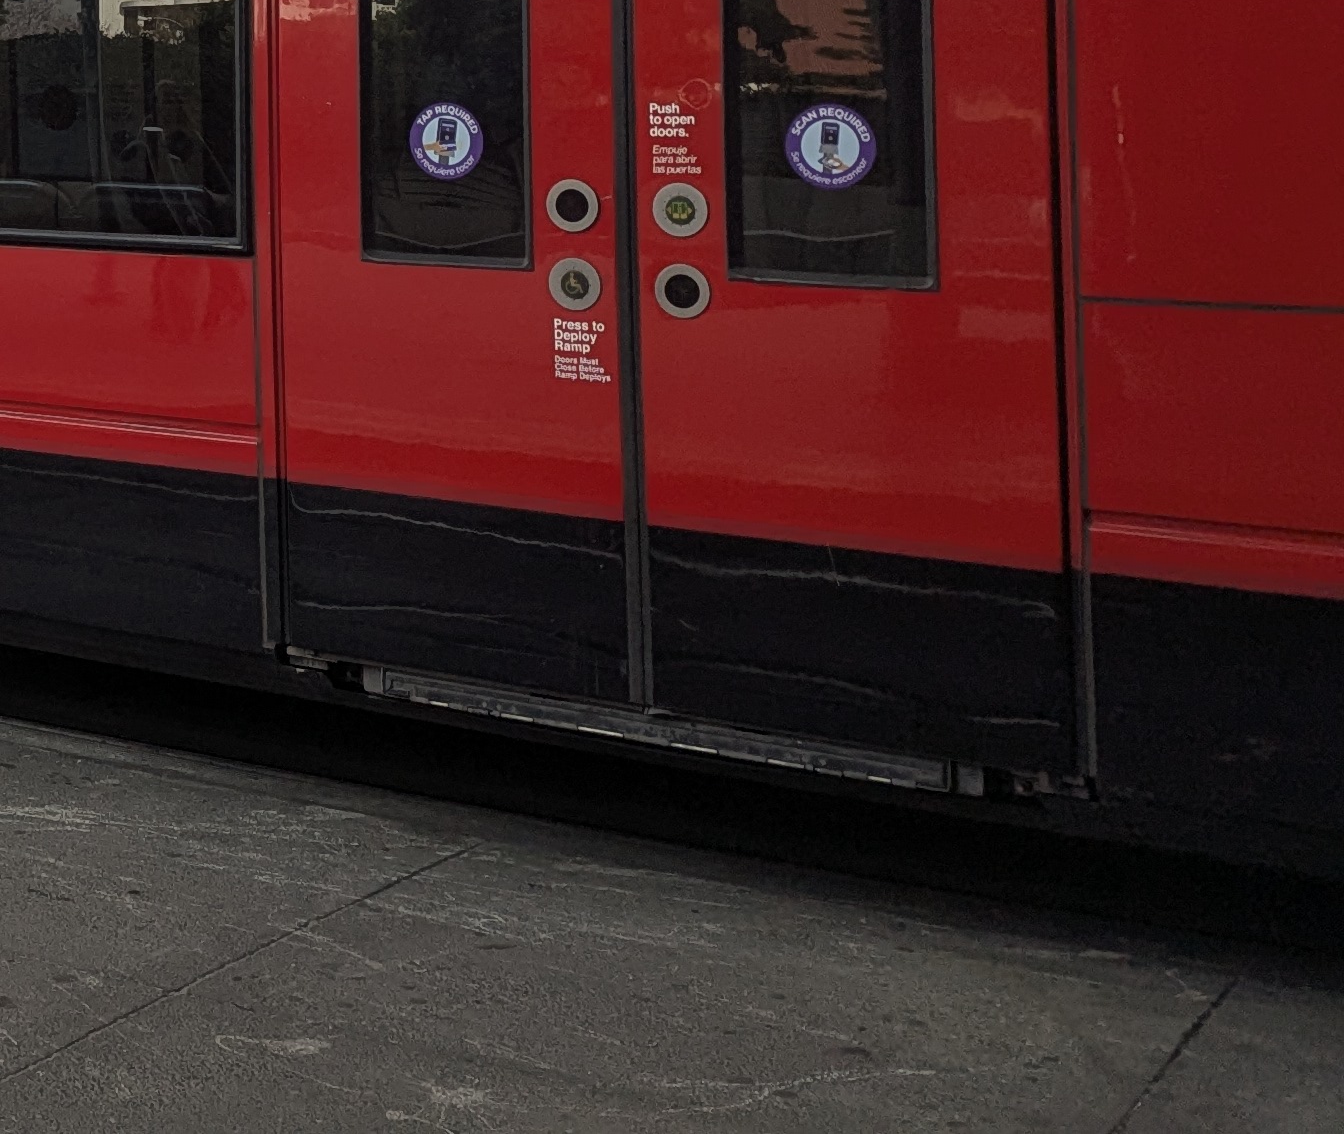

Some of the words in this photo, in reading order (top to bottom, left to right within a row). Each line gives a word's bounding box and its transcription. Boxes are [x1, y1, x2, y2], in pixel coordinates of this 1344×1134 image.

[649, 102, 680, 114] Push
[417, 109, 433, 125] TAP
[434, 105, 478, 134] REQUIRED
[649, 114, 662, 125] to
[663, 115, 695, 127] open
[792, 109, 817, 136] SCAN
[819, 108, 870, 142] REQUIRED
[649, 126, 689, 137] doors.
[456, 154, 475, 174] tocar
[652, 156, 673, 166] para
[675, 154, 697, 164] abrir
[652, 164, 665, 174] las
[666, 166, 702, 175] puertas
[791, 151, 799, 163] Se
[796, 162, 831, 185] requiere
[832, 157, 867, 185] escanear
[554, 318, 589, 330] Press
[592, 321, 605, 332] to
[554, 329, 597, 345] Deploy
[554, 340, 591, 355] Ramp
[554, 355, 577, 364] Doors
